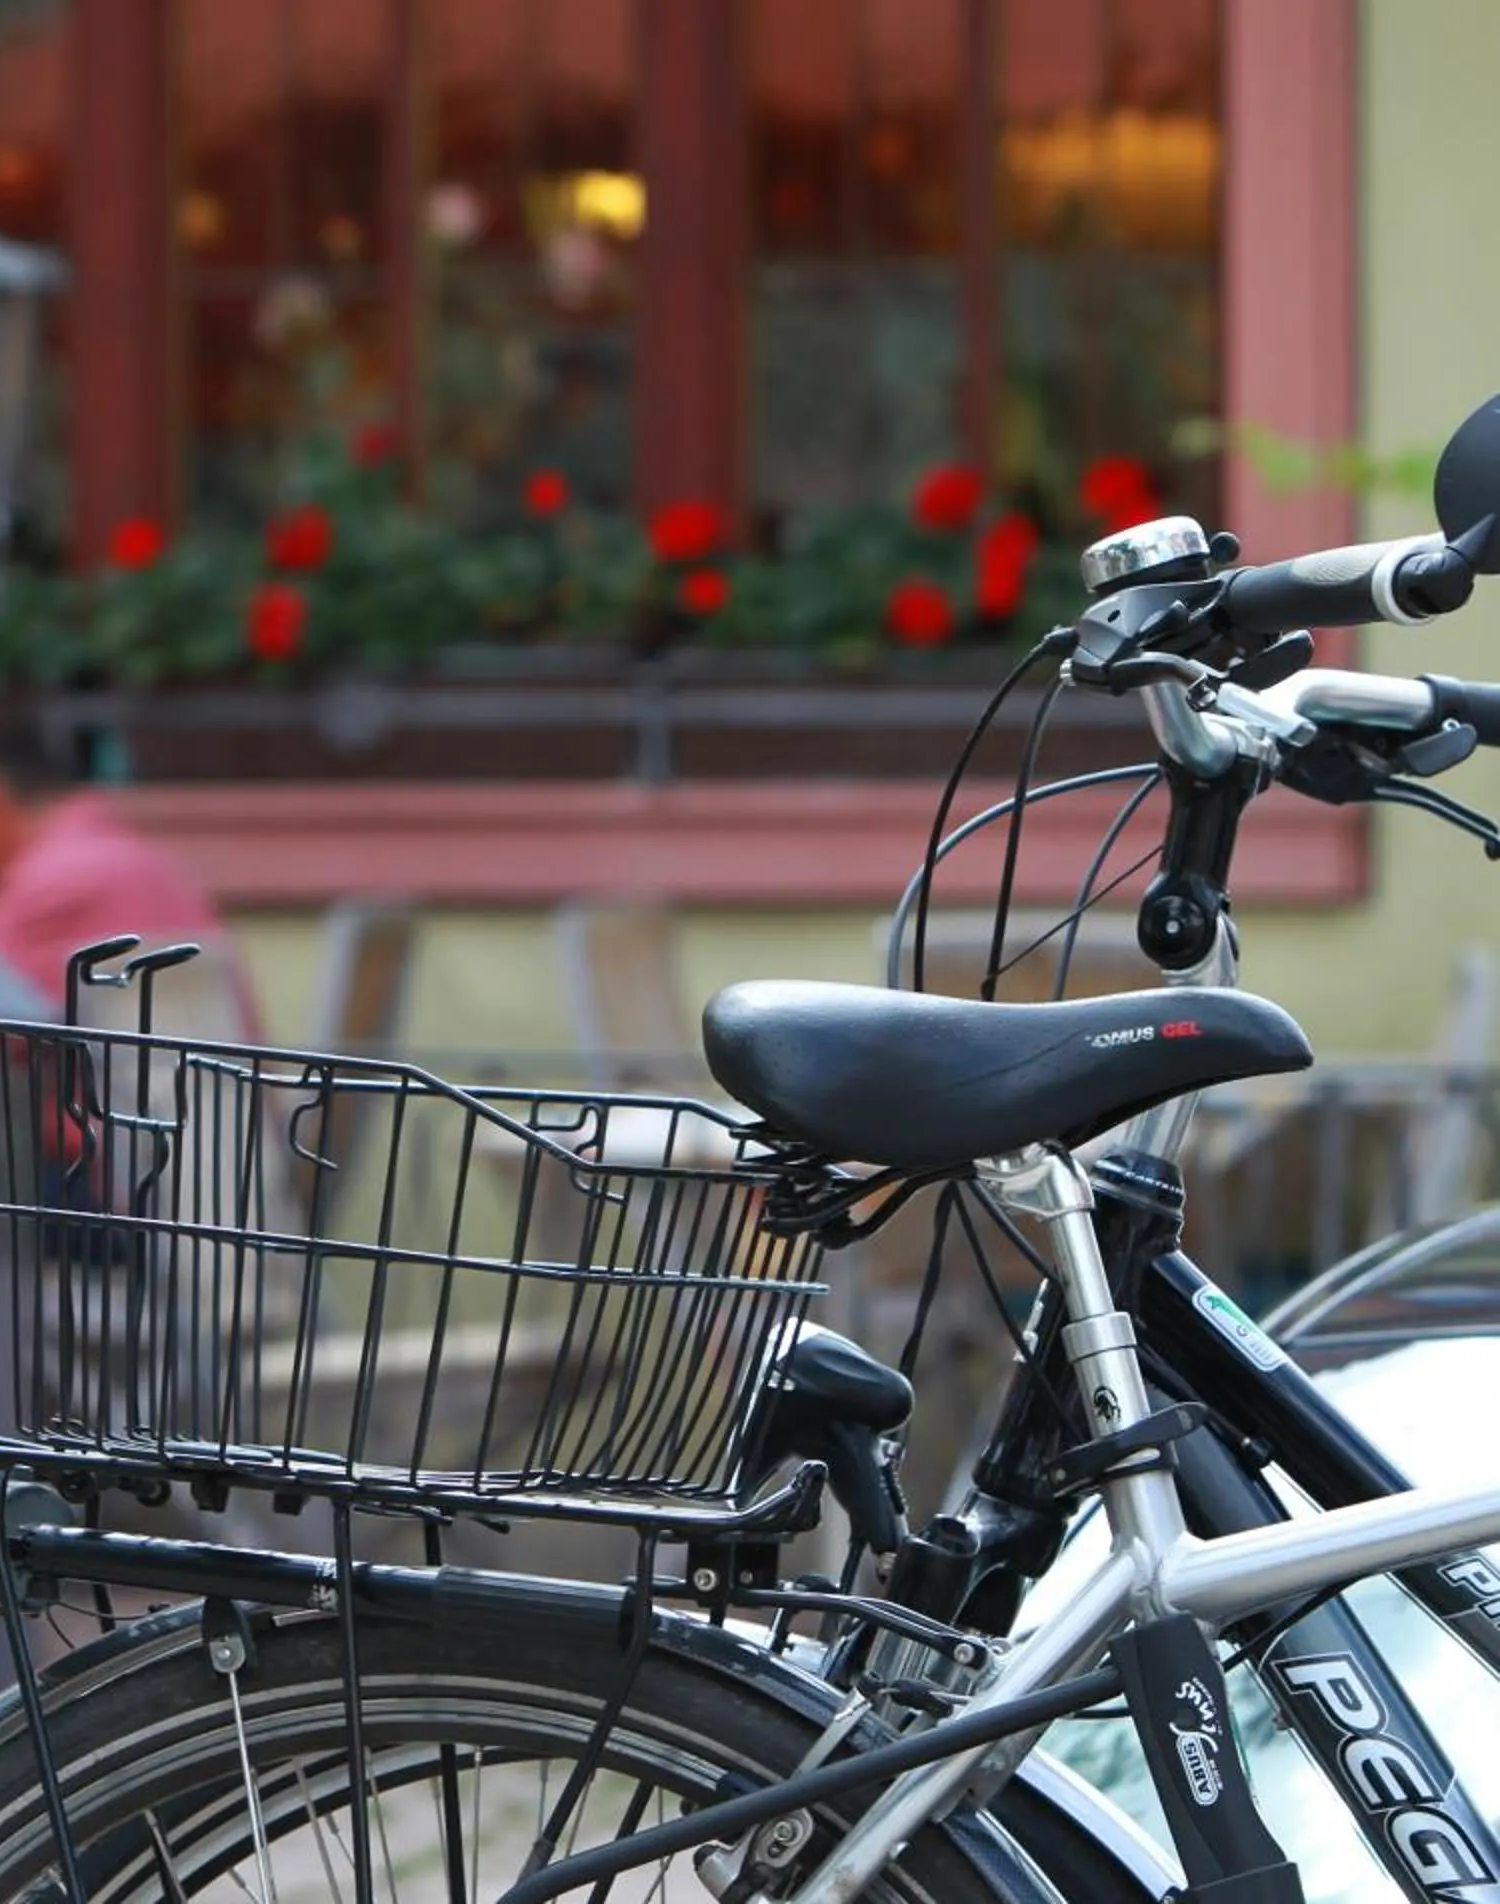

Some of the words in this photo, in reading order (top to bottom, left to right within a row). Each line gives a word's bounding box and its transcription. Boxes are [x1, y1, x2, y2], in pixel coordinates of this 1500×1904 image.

[1161, 1021, 1202, 1038] GEL
[1183, 1741, 1212, 1793] ABUS
[1274, 1654, 1498, 1903] PEG
